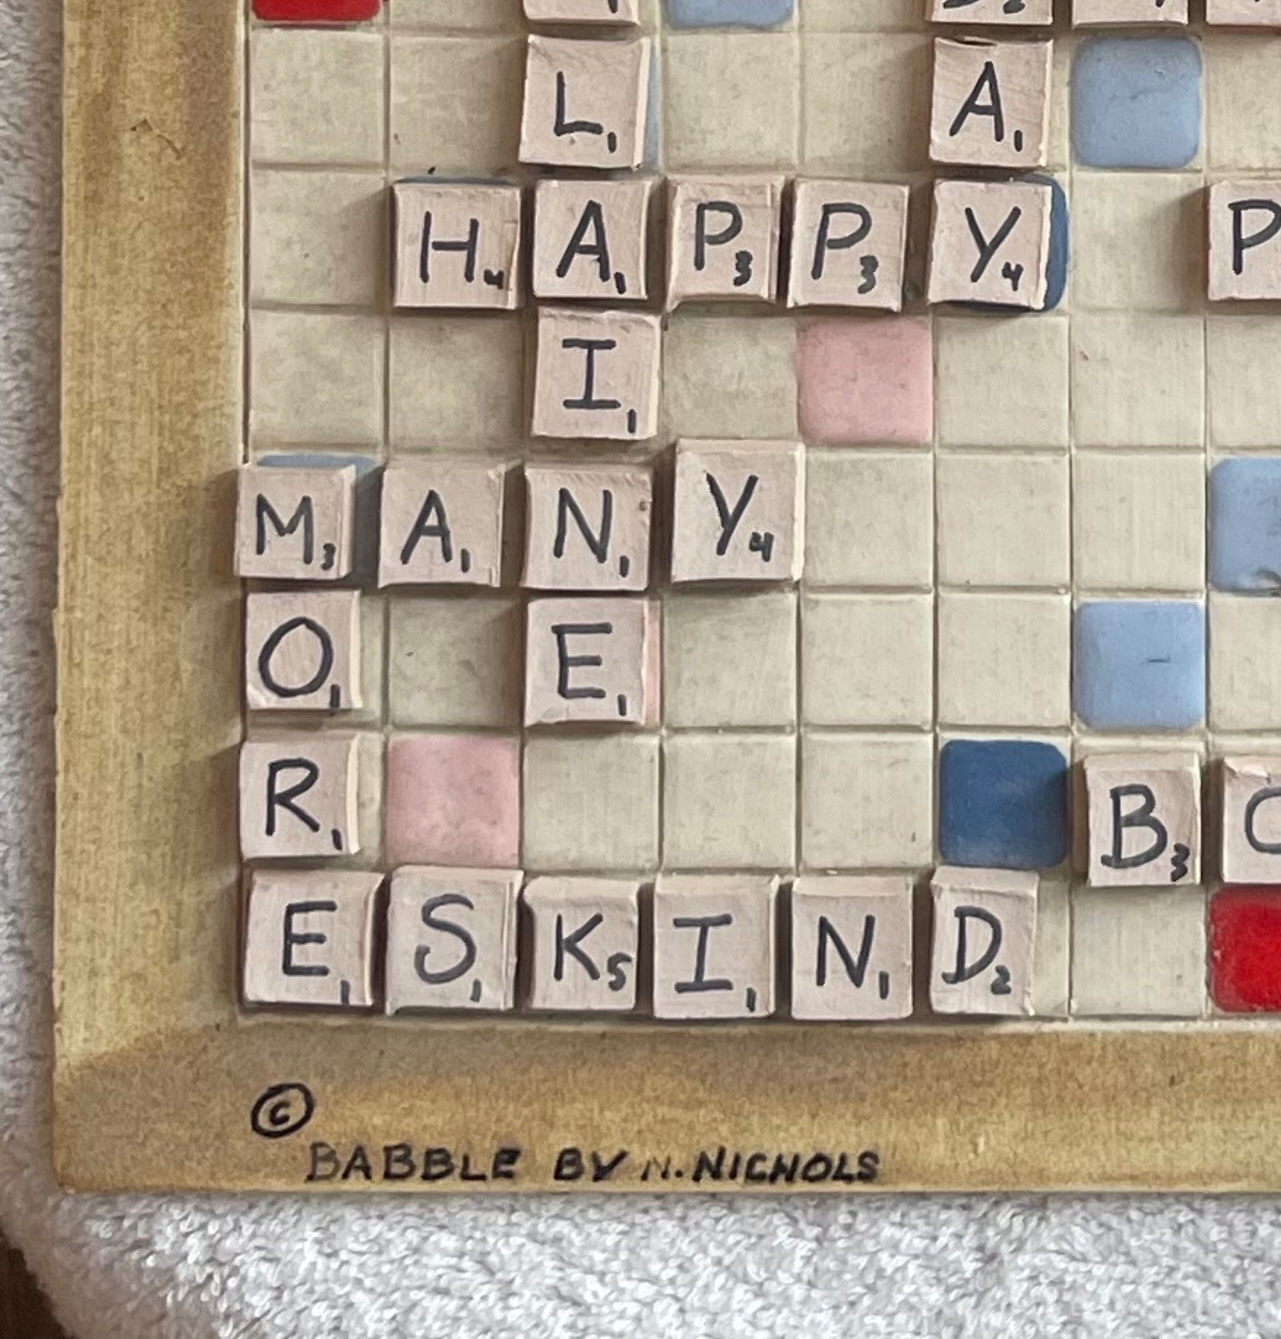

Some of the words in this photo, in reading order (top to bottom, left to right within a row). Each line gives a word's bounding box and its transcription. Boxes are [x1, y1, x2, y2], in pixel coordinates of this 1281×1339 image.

[419, 199, 1023, 285] HAPPY
[255, 472, 759, 566] MANY
[281, 891, 1004, 995] ESKIND
[304, 1141, 522, 1182] BABBLE
[553, 1146, 631, 1182] BY
